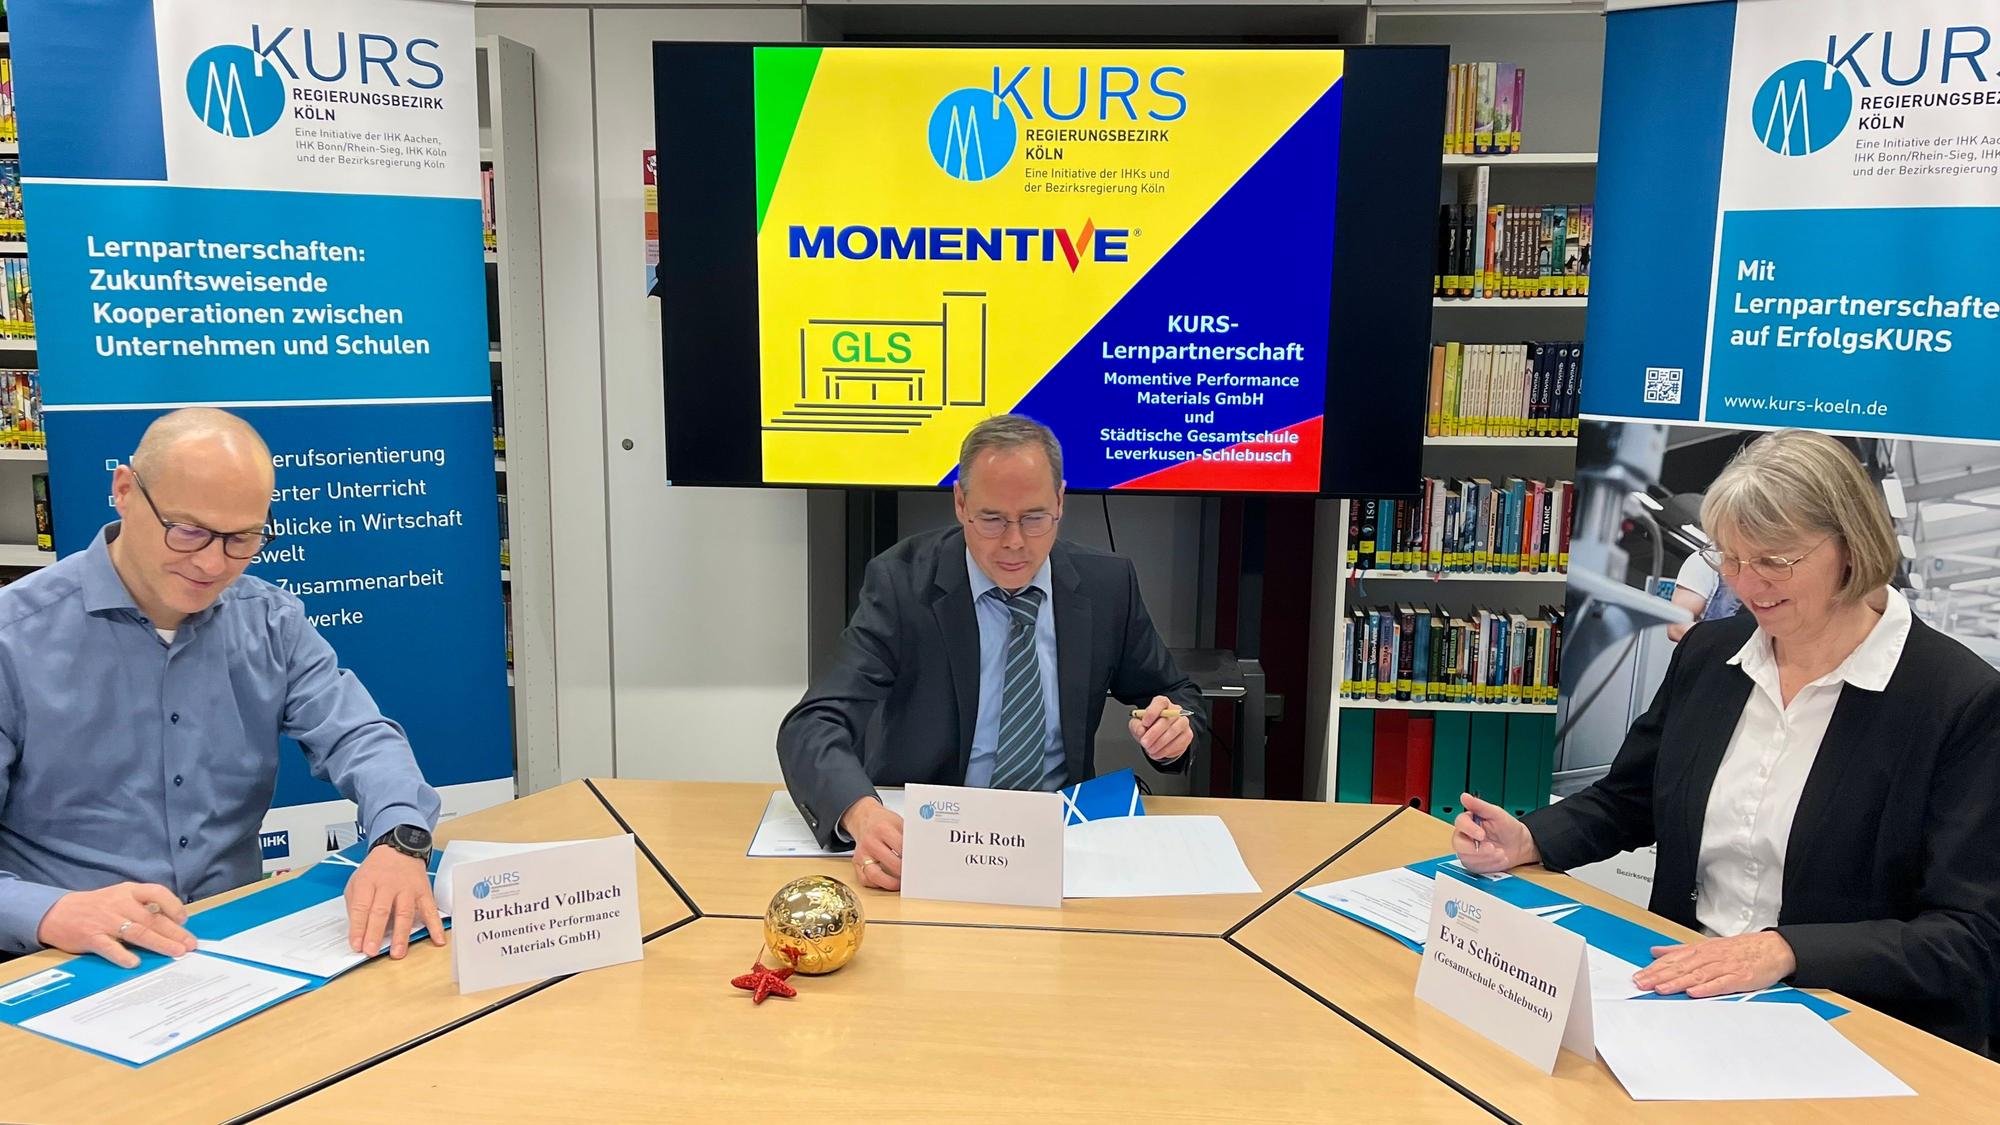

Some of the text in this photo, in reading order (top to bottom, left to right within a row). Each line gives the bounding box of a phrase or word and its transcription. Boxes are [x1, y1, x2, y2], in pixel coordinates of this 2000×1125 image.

[252, 24, 444, 89] KURS
[1823, 26, 2000, 90] KUR
[293, 88, 443, 109] REGIERUNGSBEZIRK
[993, 65, 1187, 121] KURS
[1861, 91, 2000, 110] REGIERUNGSBE
[294, 105, 335, 121] KÖLN
[1858, 113, 1905, 130] KÖLN
[295, 128, 441, 145] Eine Initiative der IHK Aachen,
[1025, 128, 1169, 142] REGIERUNGSBEZIRK
[1856, 139, 1880, 149] Eine
[1883, 138, 1930, 148] Initiative
[1934, 136, 1952, 146] der
[1956, 136, 1978, 145] IHK
[296, 141, 315, 150] IHK
[317, 142, 404, 156] Bonn/Rhein-Sieg,
[406, 147, 423, 155] IHK
[1025, 144, 1063, 160] KÖLN
[1854, 149, 2000, 163] IHK Bonn/Rhein-Sieg, IHK
[297, 155, 315, 163] und
[319, 155, 335, 163] der
[338, 155, 422, 169] Bezirksregierung
[1853, 164, 1998, 176] und der Bezirksregierung
[1024, 168, 1170, 179] Eine Initiative der IHKs und
[1024, 181, 1165, 195] der Bezirksregierung Köln
[88, 236, 366, 262] Lernpartnerschaften:
[1737, 260, 1776, 282] Mit
[89, 269, 328, 293] Zukunftsweisende
[93, 302, 403, 328] Kooperationen zwischen
[1734, 292, 2000, 319] Lernpartnerschafte
[1167, 315, 1239, 333] KURS-
[95, 334, 430, 357] Unternehmen und Schulen
[831, 330, 912, 364] GLS
[1730, 325, 1953, 354] auf ErfolgsKURS
[1101, 341, 1304, 363] Lernpartnerschaft
[1103, 372, 1300, 388] Momentive Performance
[1137, 391, 1264, 406] Materials GmbH
[1724, 396, 1888, 416] www.kurs-koeln.de
[1184, 410, 1215, 424] und
[1099, 428, 1299, 444] Städtische Gesamtschule
[272, 447, 445, 468] erufsorientierung
[1105, 447, 1292, 463] Leverkusen-Schlebusch
[271, 479, 427, 501] erter Unterricht
[1366, 500, 1375, 520] ISO
[339, 516, 356, 533] in
[361, 510, 463, 531] Wirtschaft
[1542, 505, 1551, 535] TITANIC
[308, 609, 363, 627] werke
[929, 801, 960, 812] KURS
[263, 834, 286, 848] IHK
[950, 829, 1025, 848] Dirk Roth
[965, 854, 1008, 868] (KURS)
[483, 871, 520, 886] KURS
[473, 885, 622, 923] Burkhard Vollbach
[1454, 899, 1482, 919] KURS
[476, 908, 621, 944] (Momentive Performance
[501, 929, 601, 956] Materials GmbH)
[1440, 925, 1557, 998] Eva Schönemann
[1434, 950, 1553, 1023] (Gesamtschule Schlebusch)
